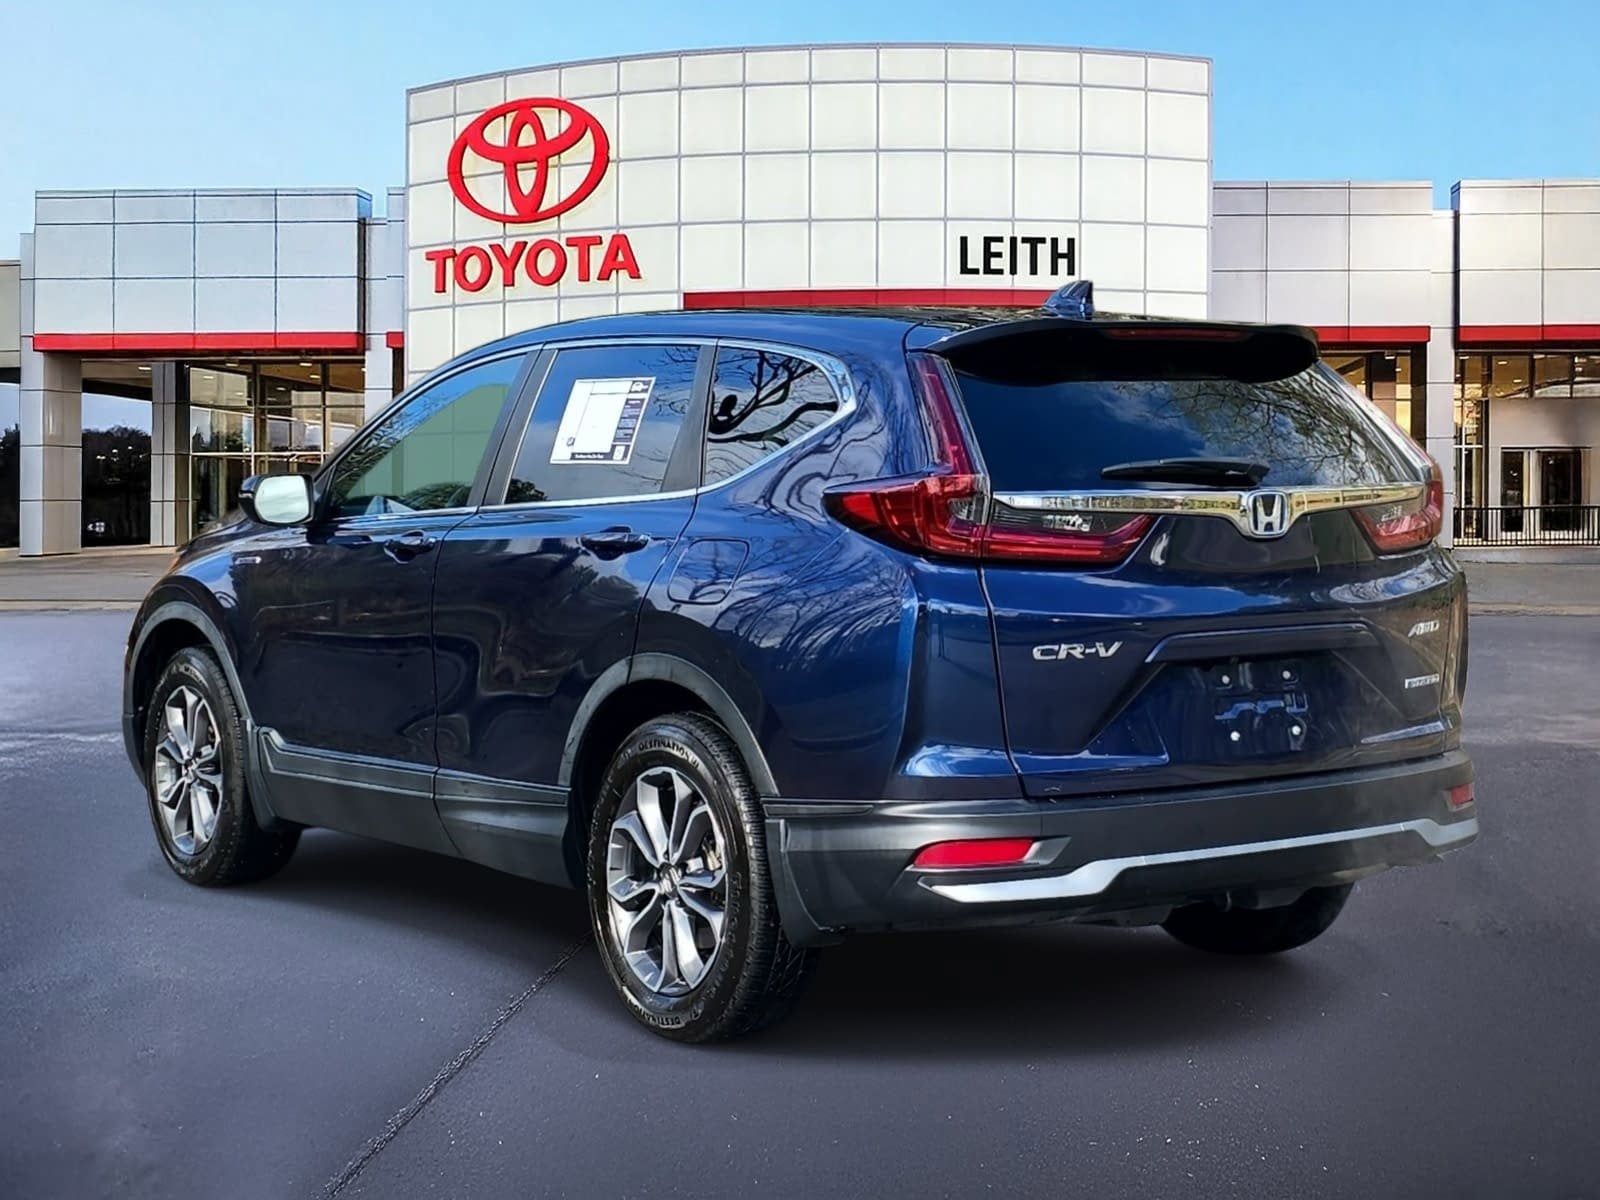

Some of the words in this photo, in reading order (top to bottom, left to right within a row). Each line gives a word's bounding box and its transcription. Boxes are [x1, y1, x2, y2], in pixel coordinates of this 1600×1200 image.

[425, 233, 642, 293] TOYOTA
[959, 236, 1076, 276] LEITH
[1032, 641, 1123, 660] CR-V
